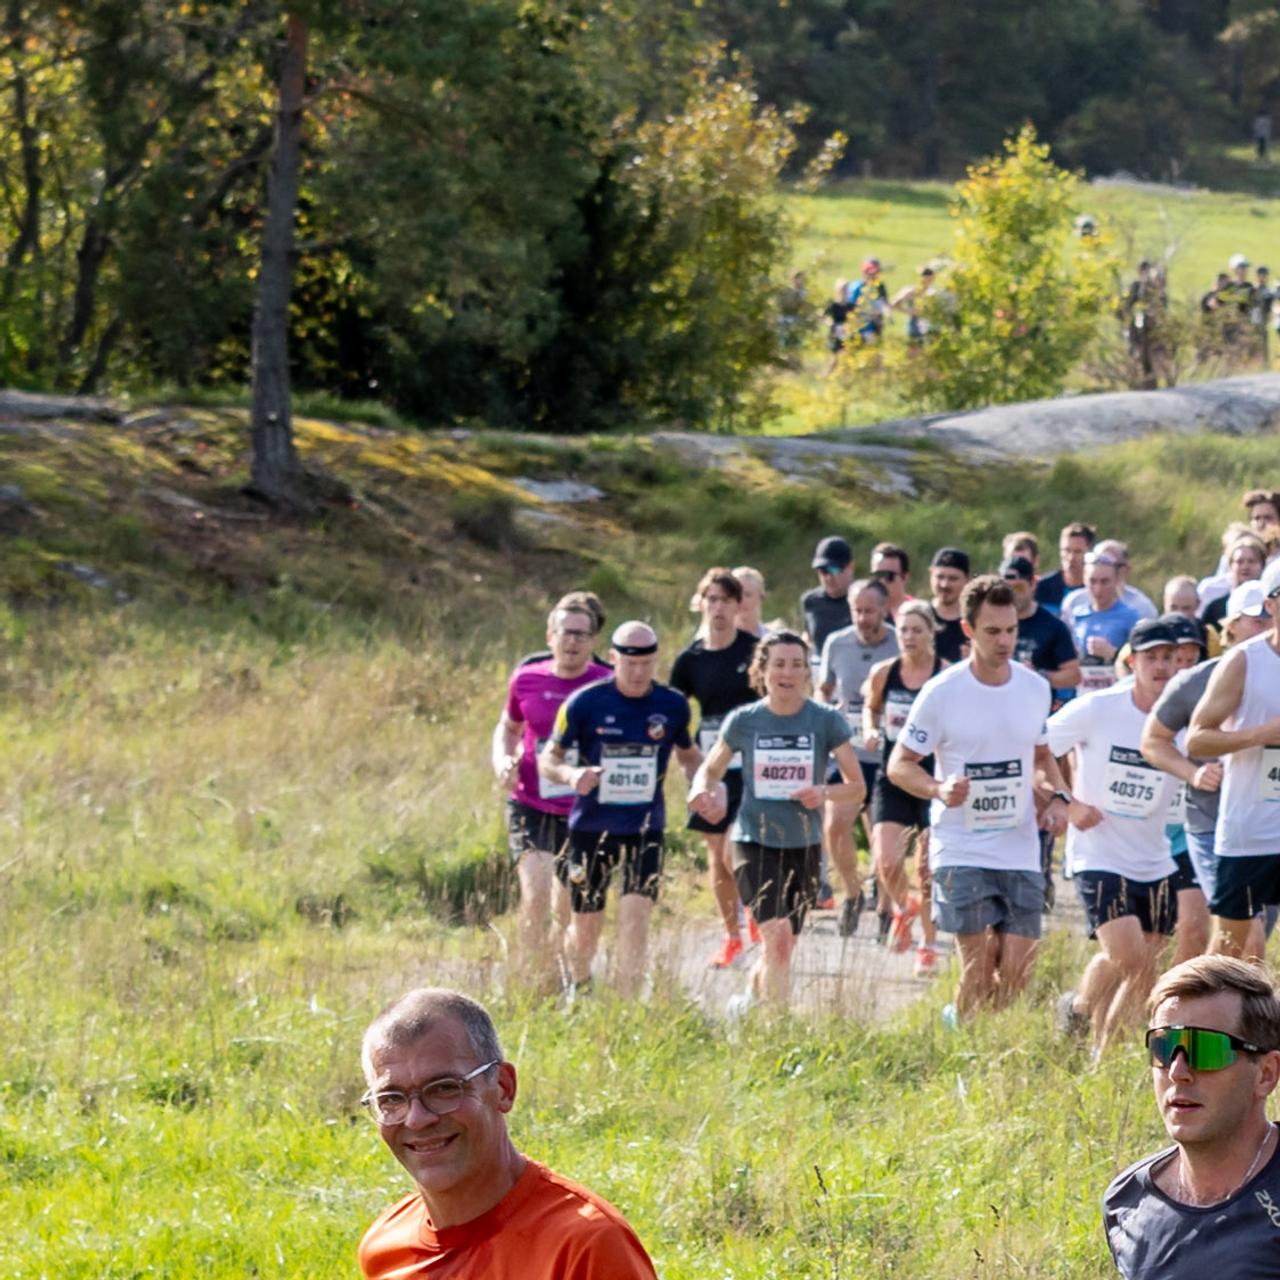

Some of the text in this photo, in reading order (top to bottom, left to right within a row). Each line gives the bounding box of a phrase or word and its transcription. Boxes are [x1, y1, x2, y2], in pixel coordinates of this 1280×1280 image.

[761, 766, 806, 781] 40270
[1109, 780, 1155, 801] 40375
[972, 795, 1016, 812] 40071
